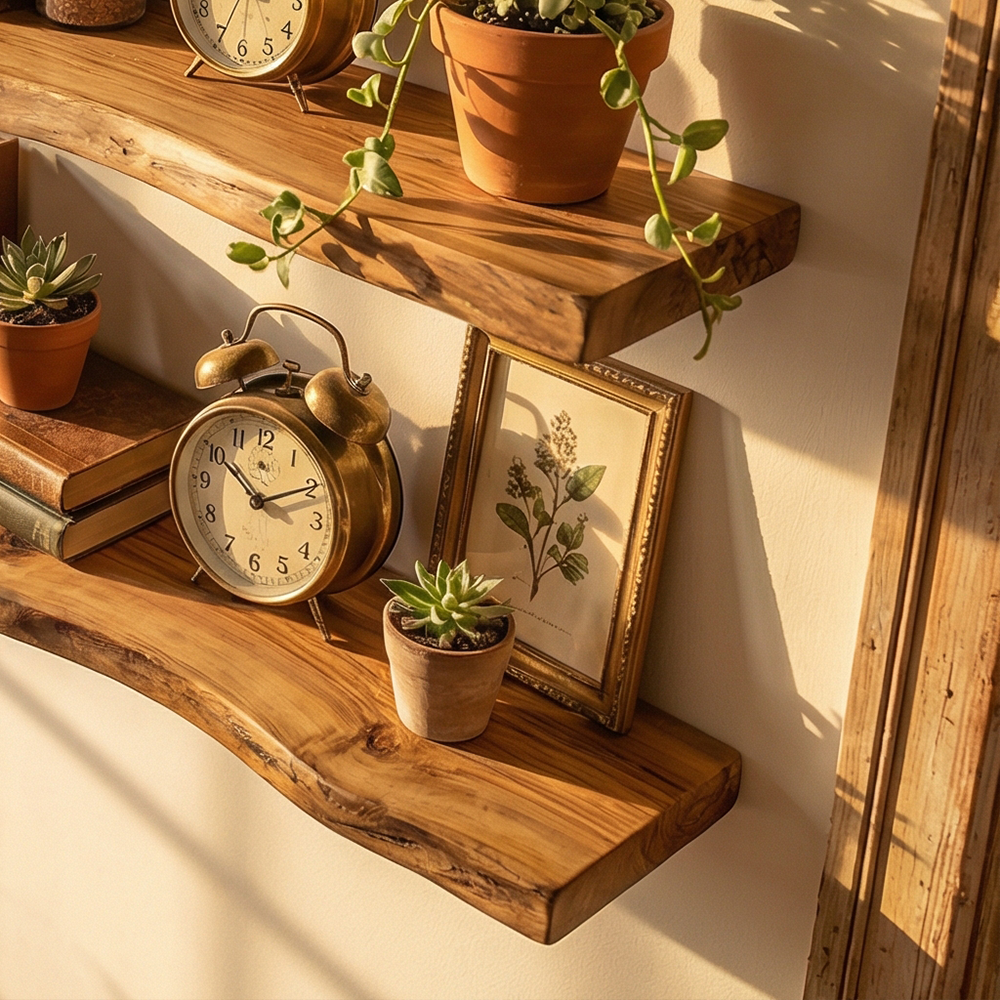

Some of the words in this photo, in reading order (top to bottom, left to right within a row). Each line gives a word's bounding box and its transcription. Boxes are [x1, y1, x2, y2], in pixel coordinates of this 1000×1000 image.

[198, 0, 209, 17] 8
[216, 23, 227, 43] 7
[280, 20, 293, 40] 4
[237, 39, 248, 57] 6
[262, 37, 273, 56] 5
[232, 428, 245, 450] 11
[257, 428, 275, 451] 12
[209, 443, 226, 466] 10
[291, 449, 297, 467] 1
[200, 471, 211, 489] 9
[305, 478, 318, 499] 2
[205, 504, 216, 523] 8
[309, 511, 323, 531] 3
[224, 534, 236, 551] 7
[297, 541, 310, 560] 4
[249, 553, 261, 572] 6
[276, 555, 289, 574] 5
